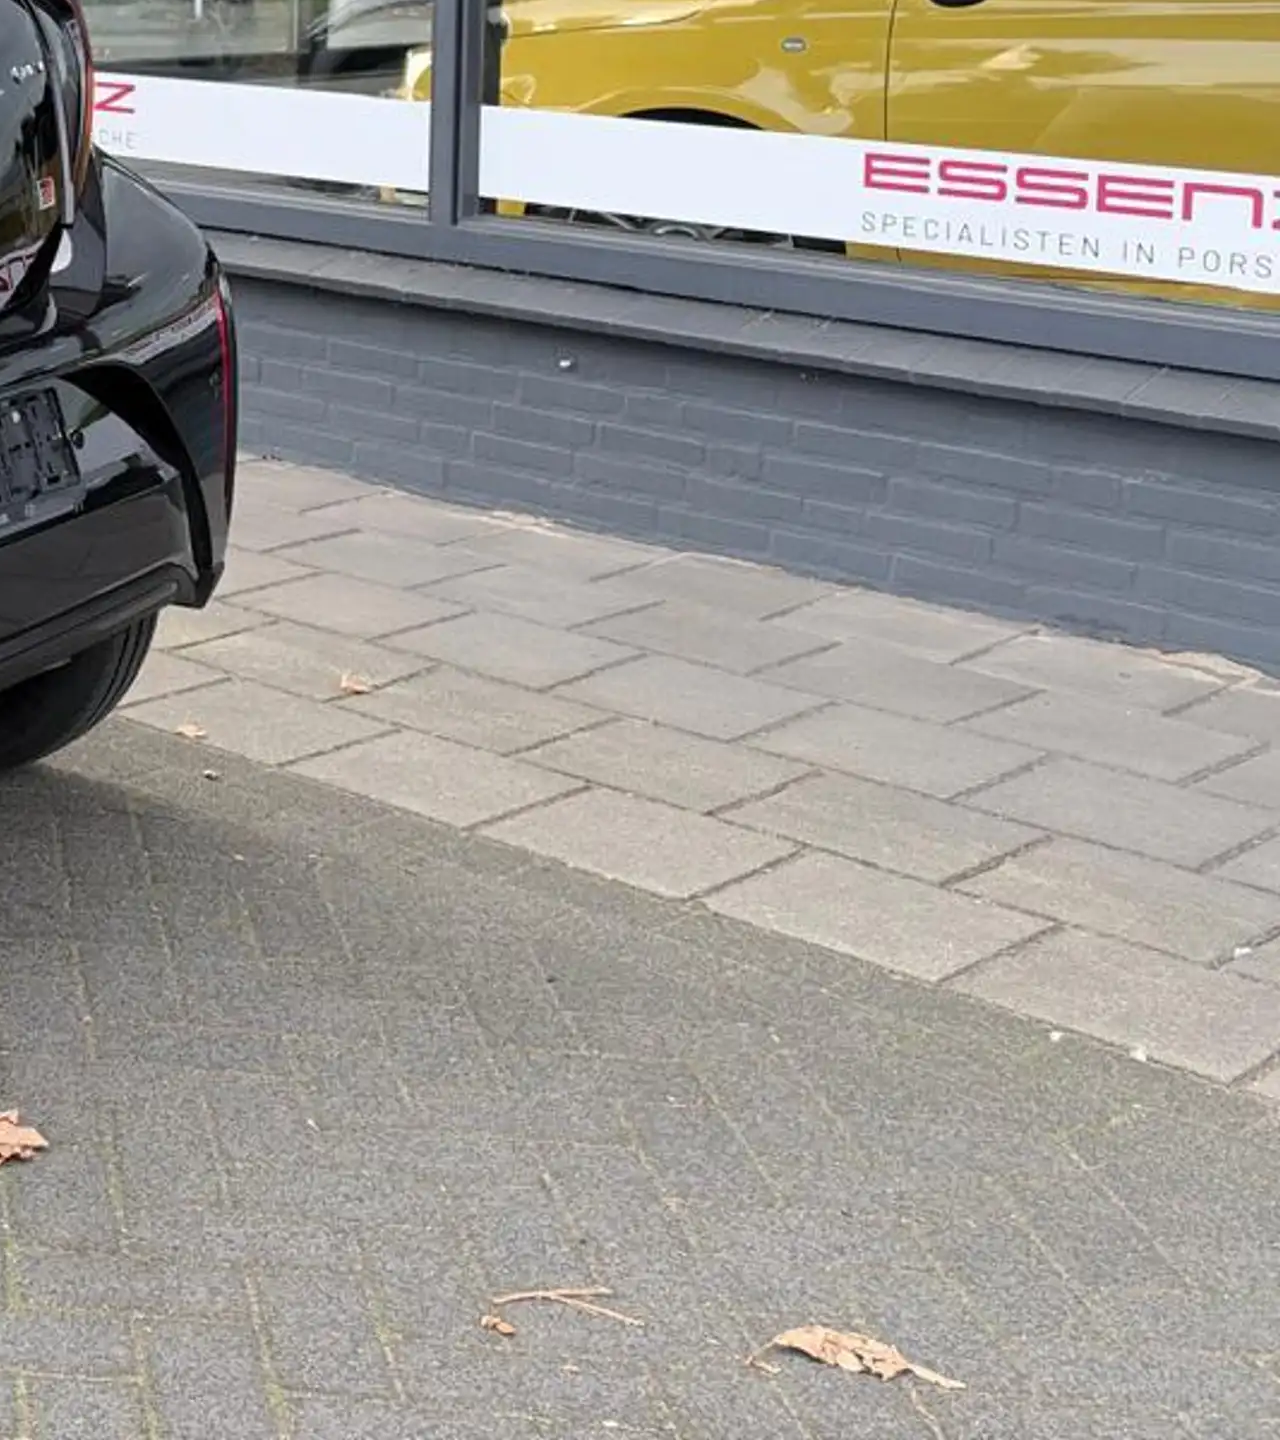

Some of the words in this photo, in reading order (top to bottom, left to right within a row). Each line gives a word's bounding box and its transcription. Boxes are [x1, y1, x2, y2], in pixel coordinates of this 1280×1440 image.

[862, 152, 1280, 229] ESSEN
[861, 210, 1101, 259] SPECIALISTEN
[1122, 239, 1155, 265] IN
[1178, 246, 1273, 279] PORS
